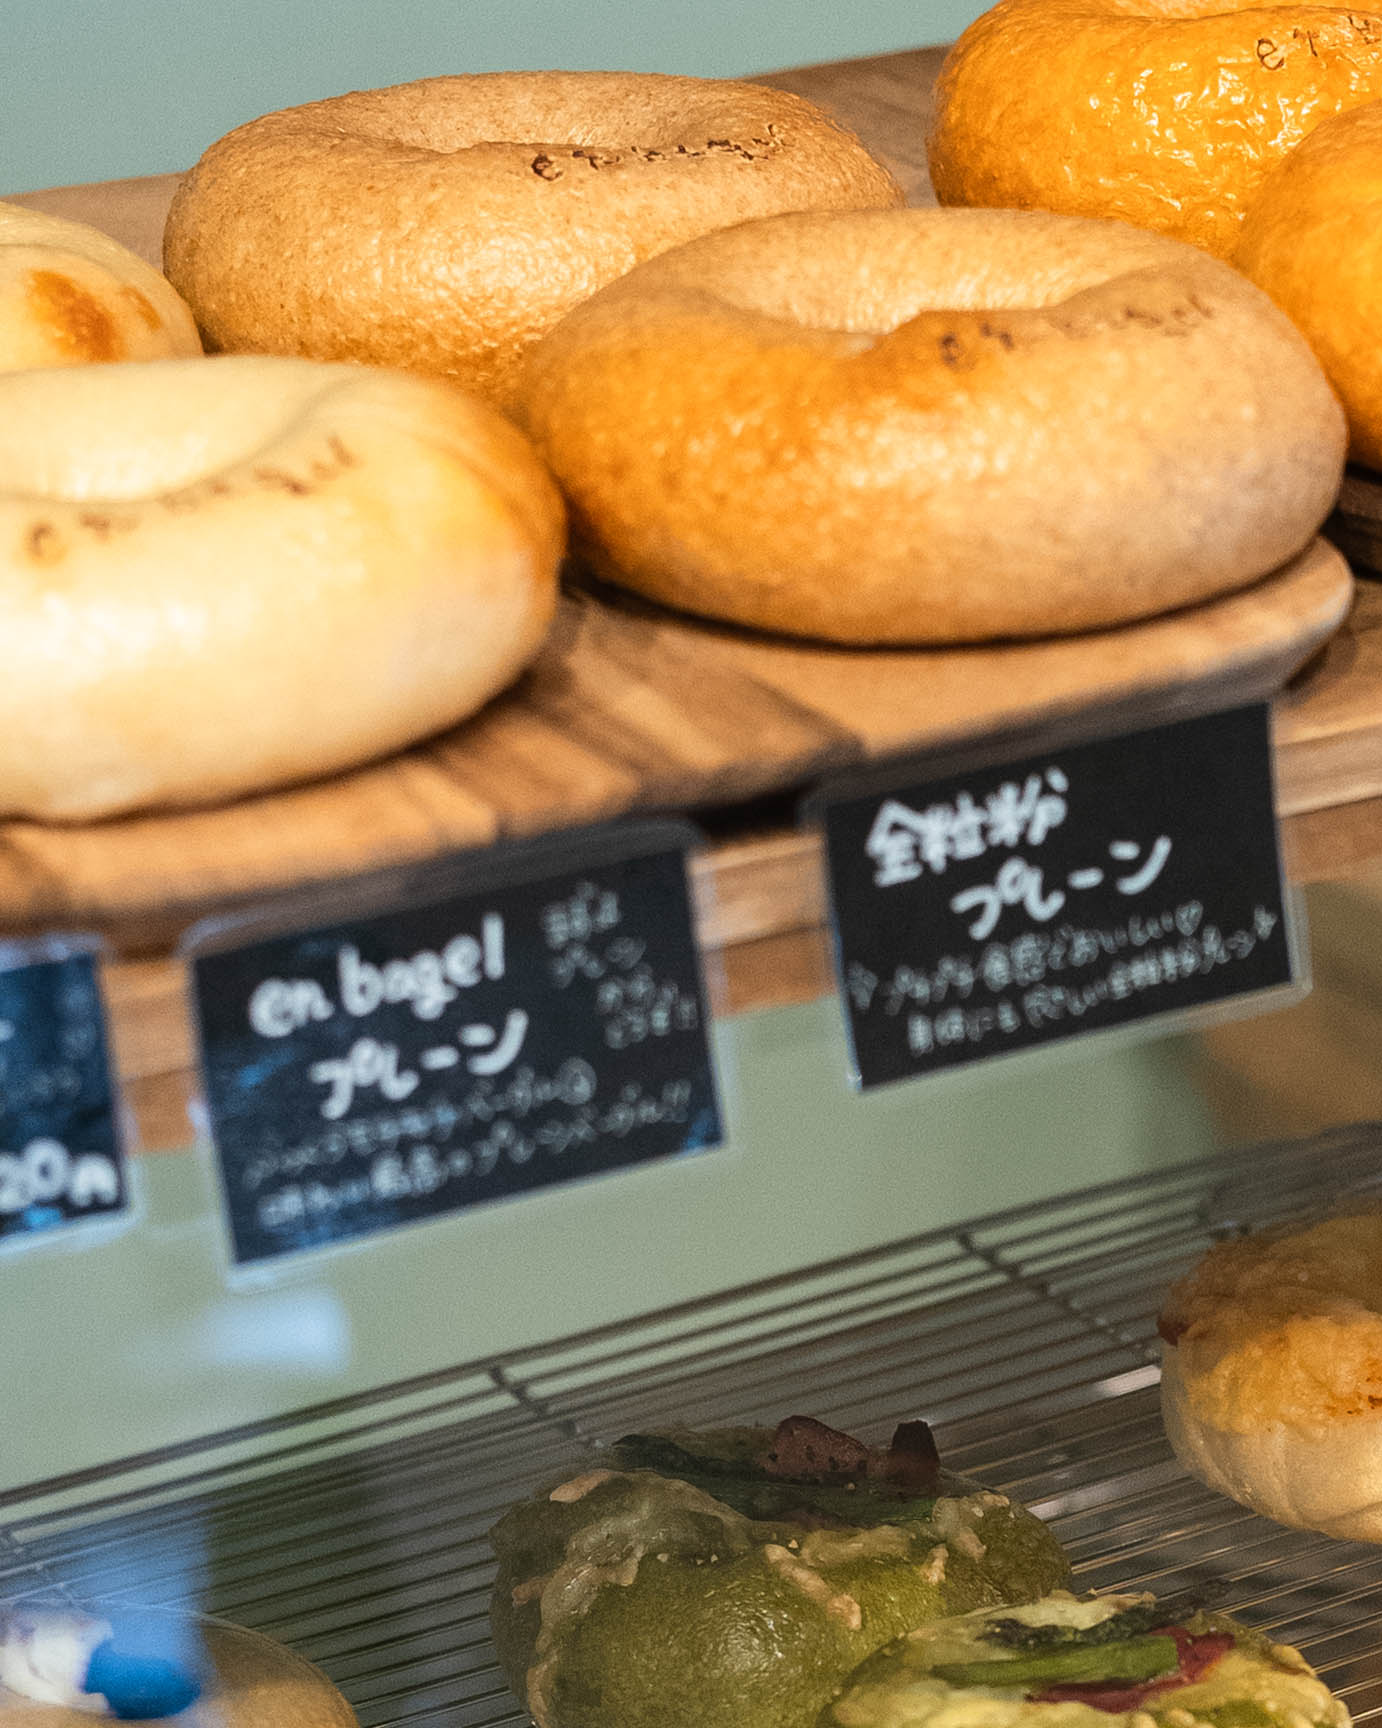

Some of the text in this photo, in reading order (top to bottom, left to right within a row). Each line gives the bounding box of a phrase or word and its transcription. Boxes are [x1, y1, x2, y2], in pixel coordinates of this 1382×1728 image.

[949, 832, 1173, 942] プレーン
[338, 912, 507, 1021] bagel
[310, 1007, 529, 1121] プレーン
